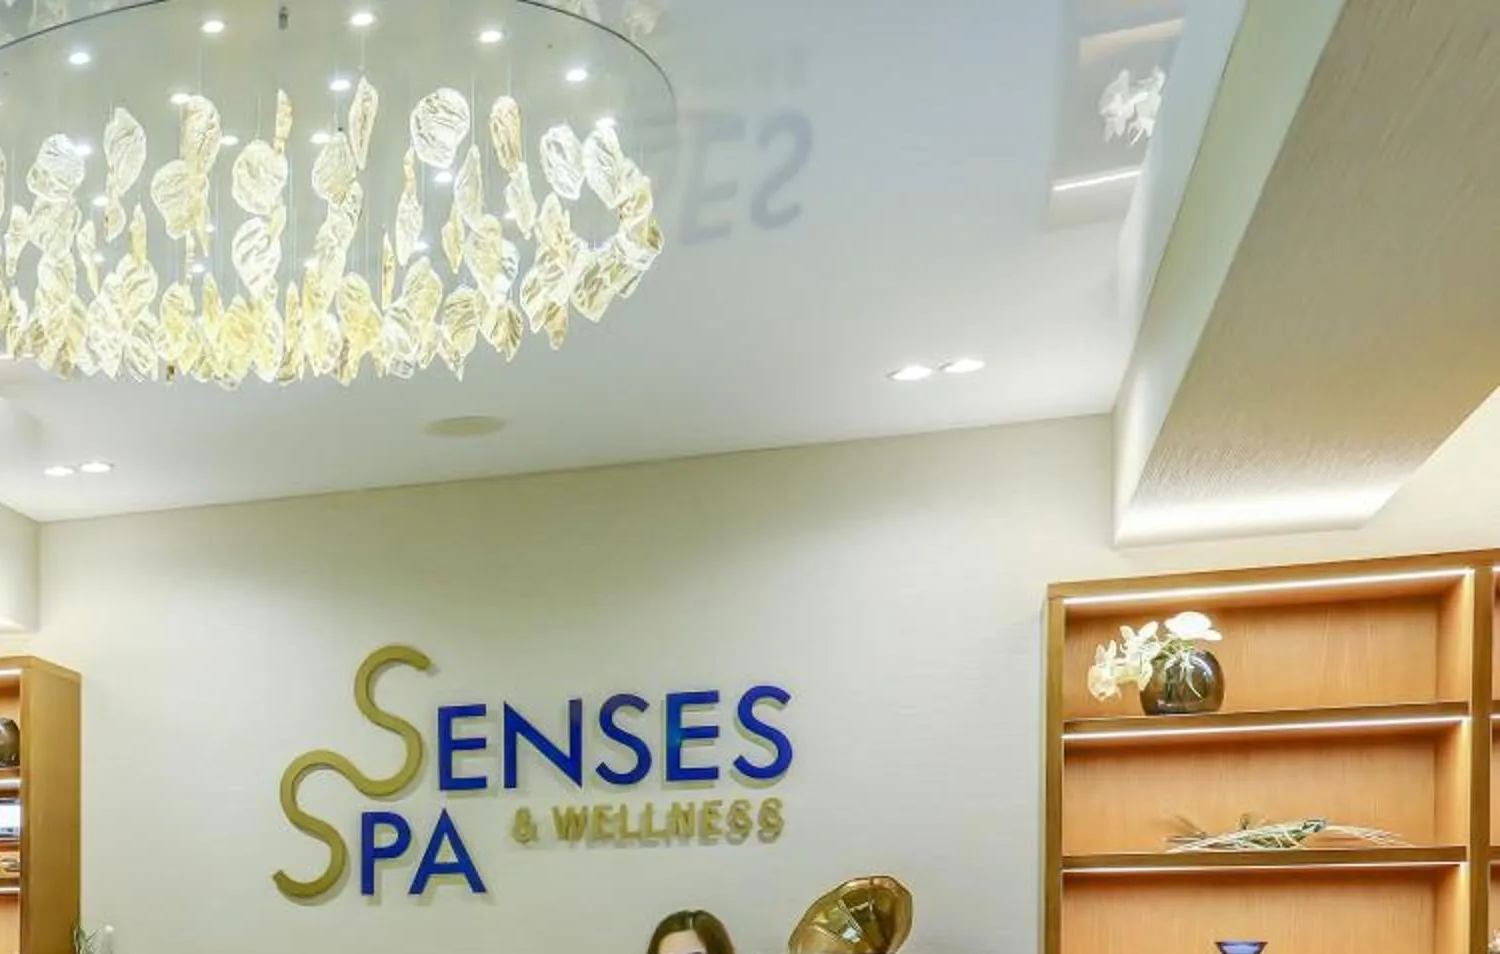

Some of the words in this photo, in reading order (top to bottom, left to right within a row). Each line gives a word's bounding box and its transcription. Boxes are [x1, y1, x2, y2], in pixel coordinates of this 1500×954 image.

[354, 644, 793, 796] SENSES
[271, 749, 487, 898] SPA
[510, 806, 538, 843] &
[553, 798, 784, 842] WELLNESS
